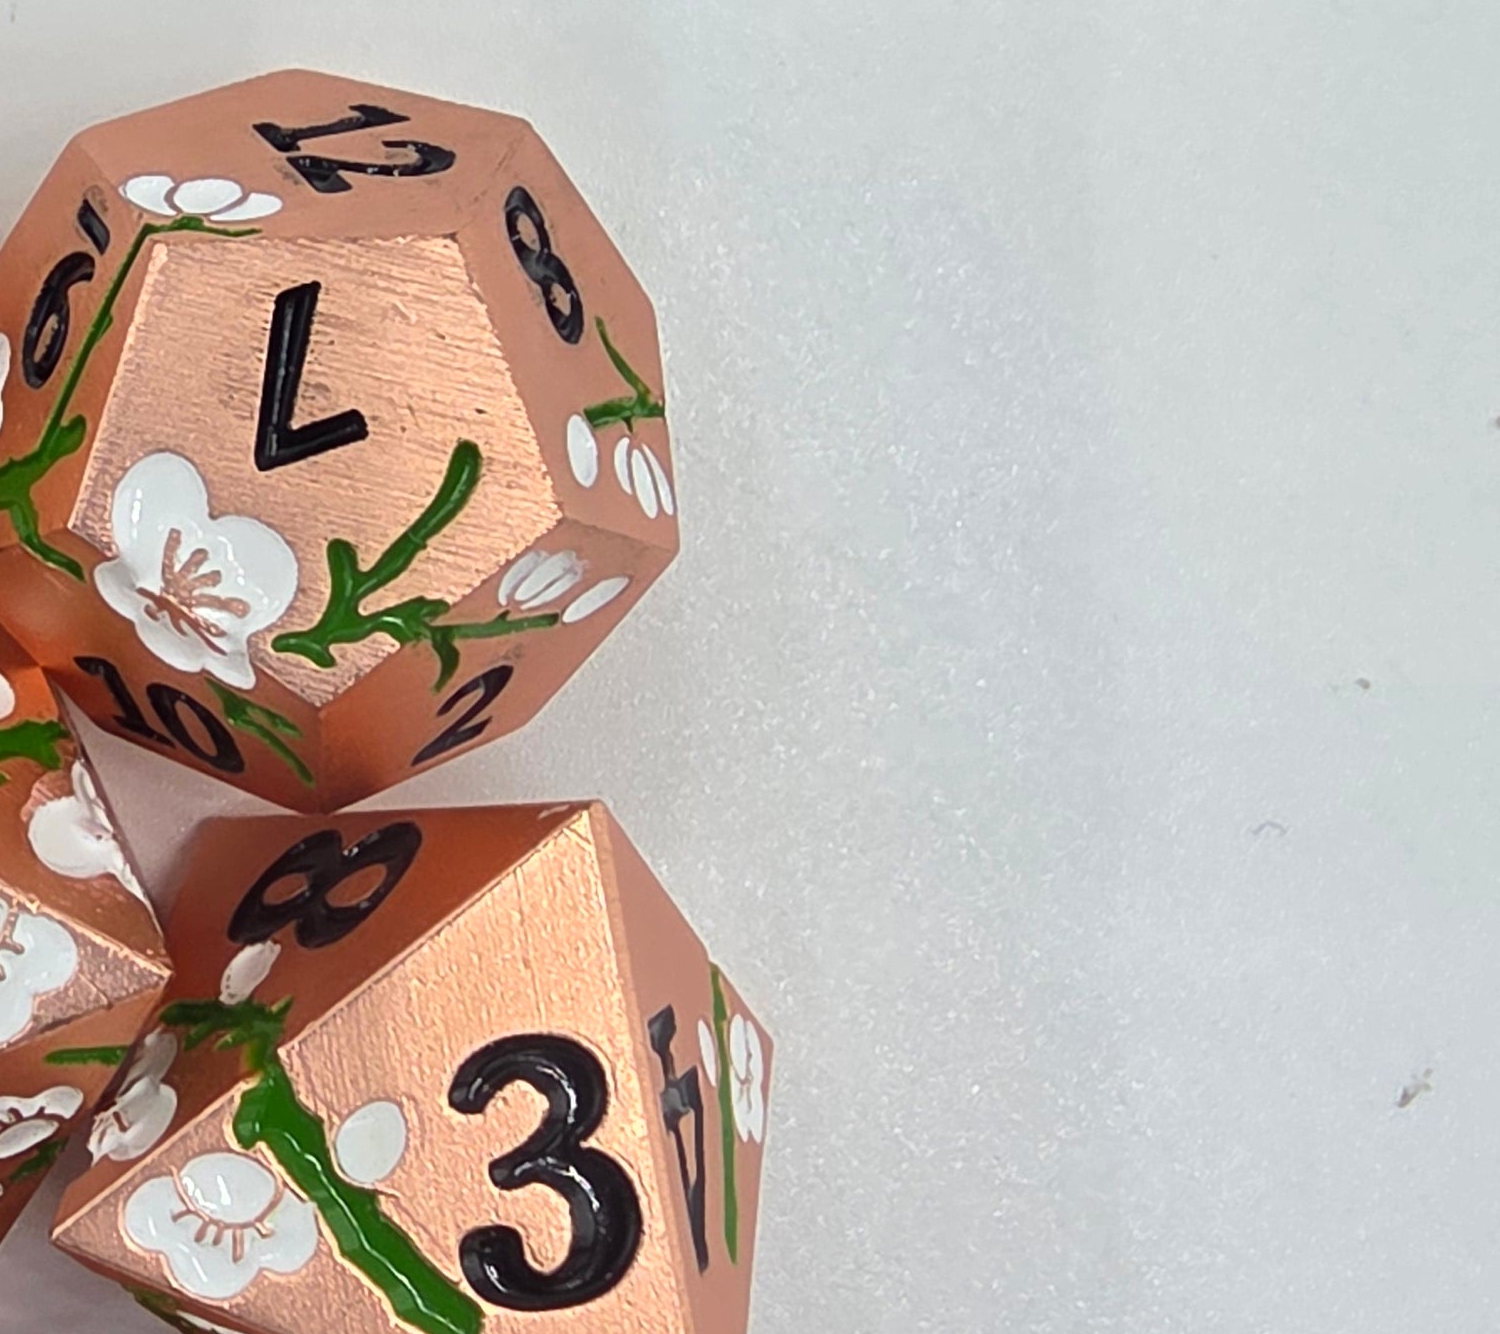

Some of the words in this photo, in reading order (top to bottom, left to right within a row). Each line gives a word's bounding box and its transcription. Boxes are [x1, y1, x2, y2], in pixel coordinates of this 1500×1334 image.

[251, 103, 457, 195] 12
[503, 185, 586, 346] 8
[253, 280, 370, 473] 7
[75, 656, 245, 774] 10
[411, 663, 515, 768] 2
[227, 821, 423, 949] 8
[446, 1031, 644, 1313] 3
